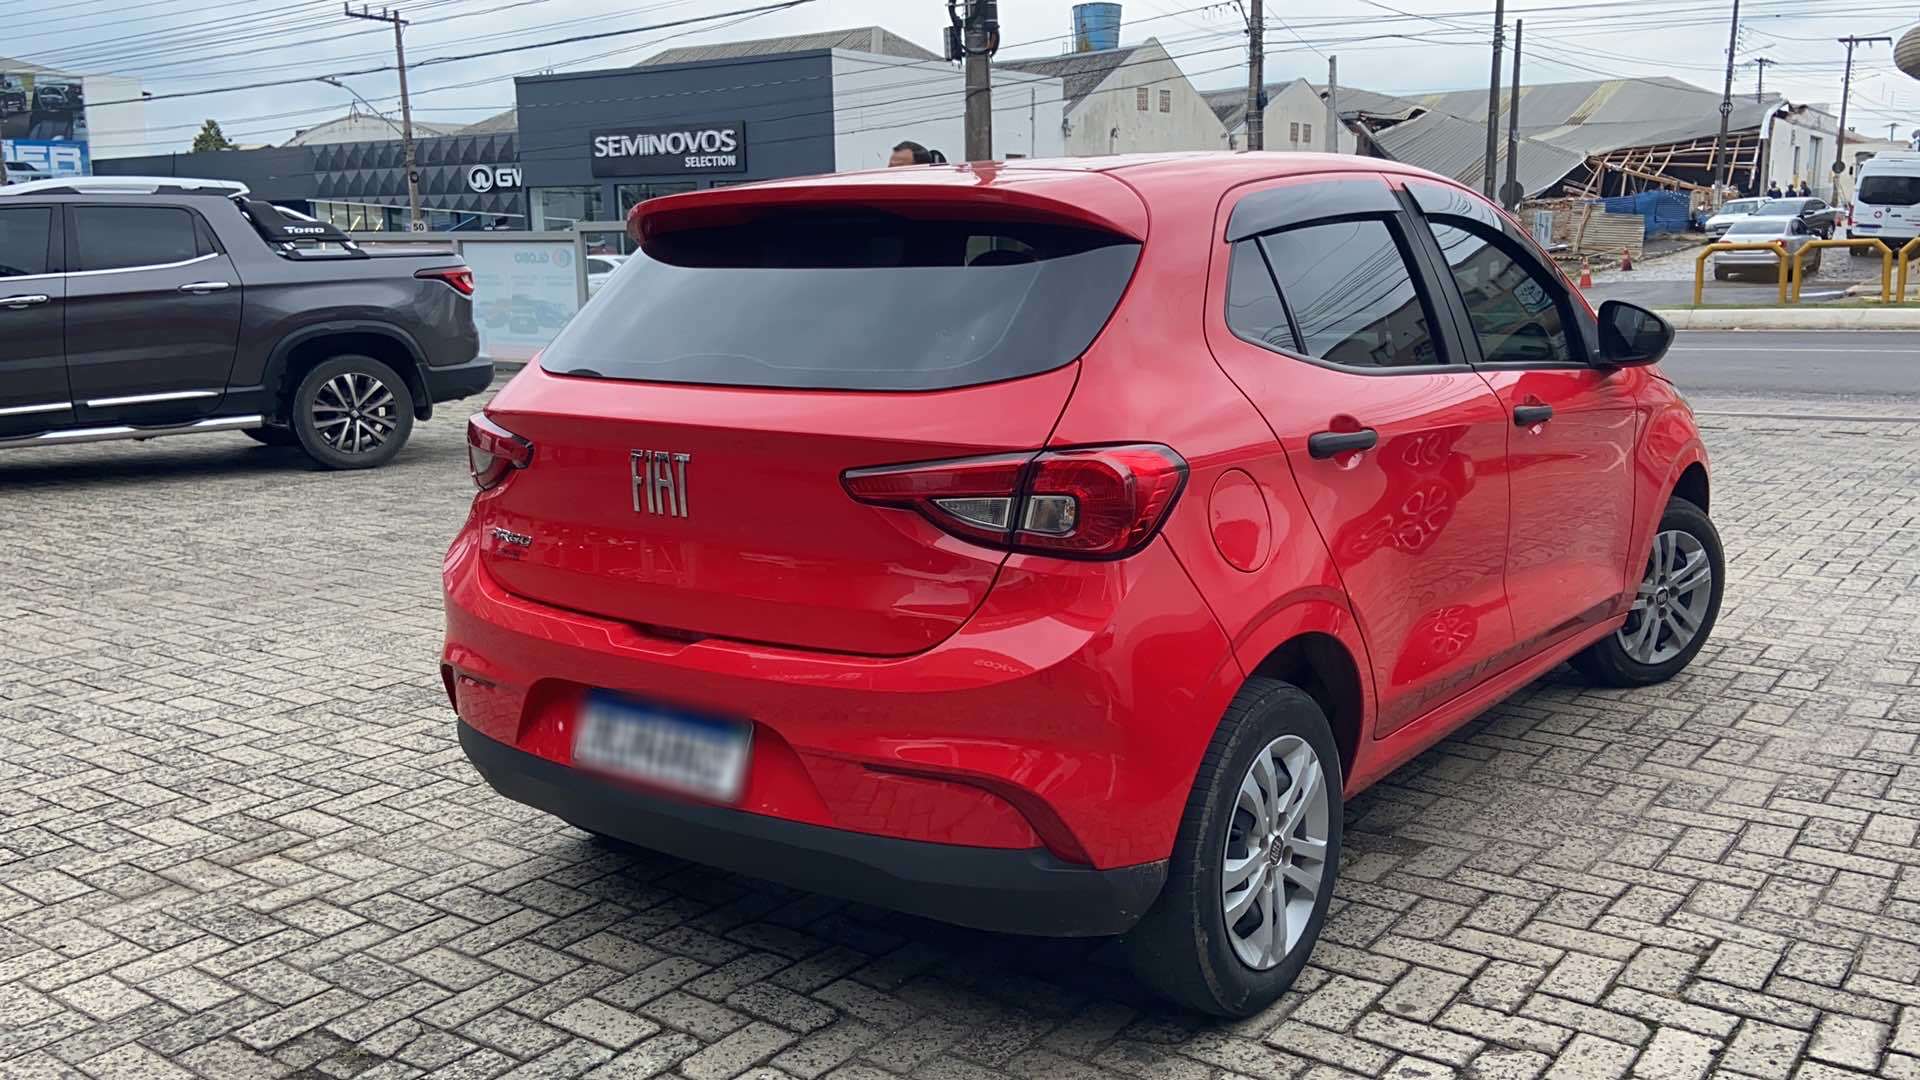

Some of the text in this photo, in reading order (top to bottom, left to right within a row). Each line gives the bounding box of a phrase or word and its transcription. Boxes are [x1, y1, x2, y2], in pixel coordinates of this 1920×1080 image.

[594, 129, 737, 158] SEMINOVOS
[685, 155, 737, 168] SELECTION
[283, 226, 325, 234] TORO
[413, 223, 425, 232] 50
[631, 449, 690, 518] FIAT
